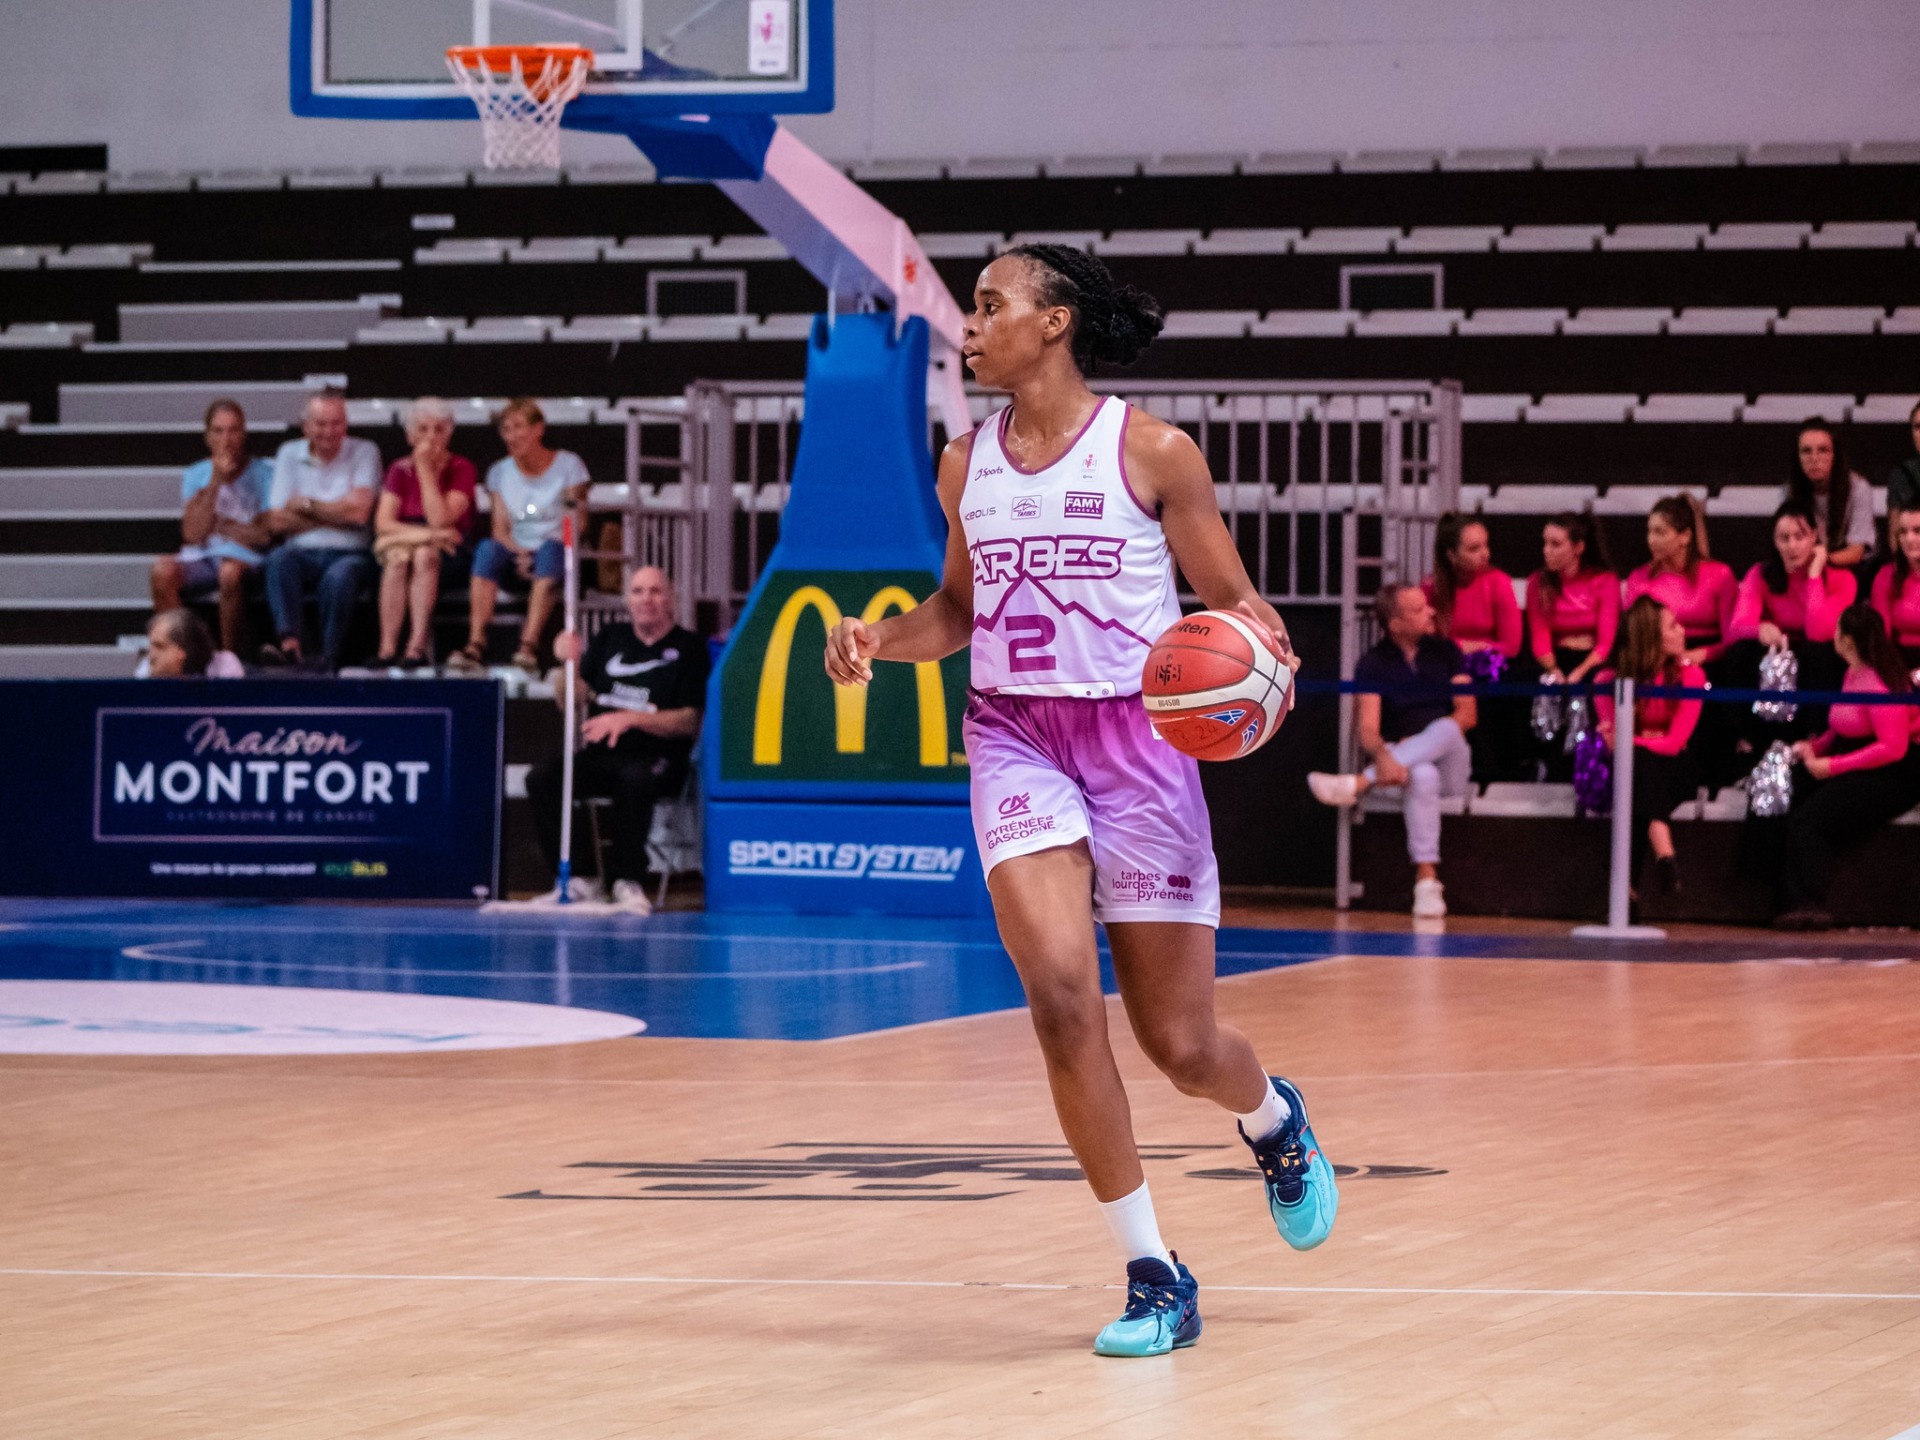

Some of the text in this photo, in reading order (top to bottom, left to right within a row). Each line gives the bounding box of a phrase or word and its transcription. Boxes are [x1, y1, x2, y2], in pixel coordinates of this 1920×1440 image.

[1065, 497, 1103, 509] FAMY
[969, 534, 1128, 586] ARBES
[1004, 614, 1057, 674] 2
[185, 716, 363, 756] Maison
[113, 760, 430, 804] MONTFORT
[1112, 877, 1156, 890] lourdes
[1121, 868, 1161, 882] tarbes
[1137, 888, 1195, 902] pyrénées
